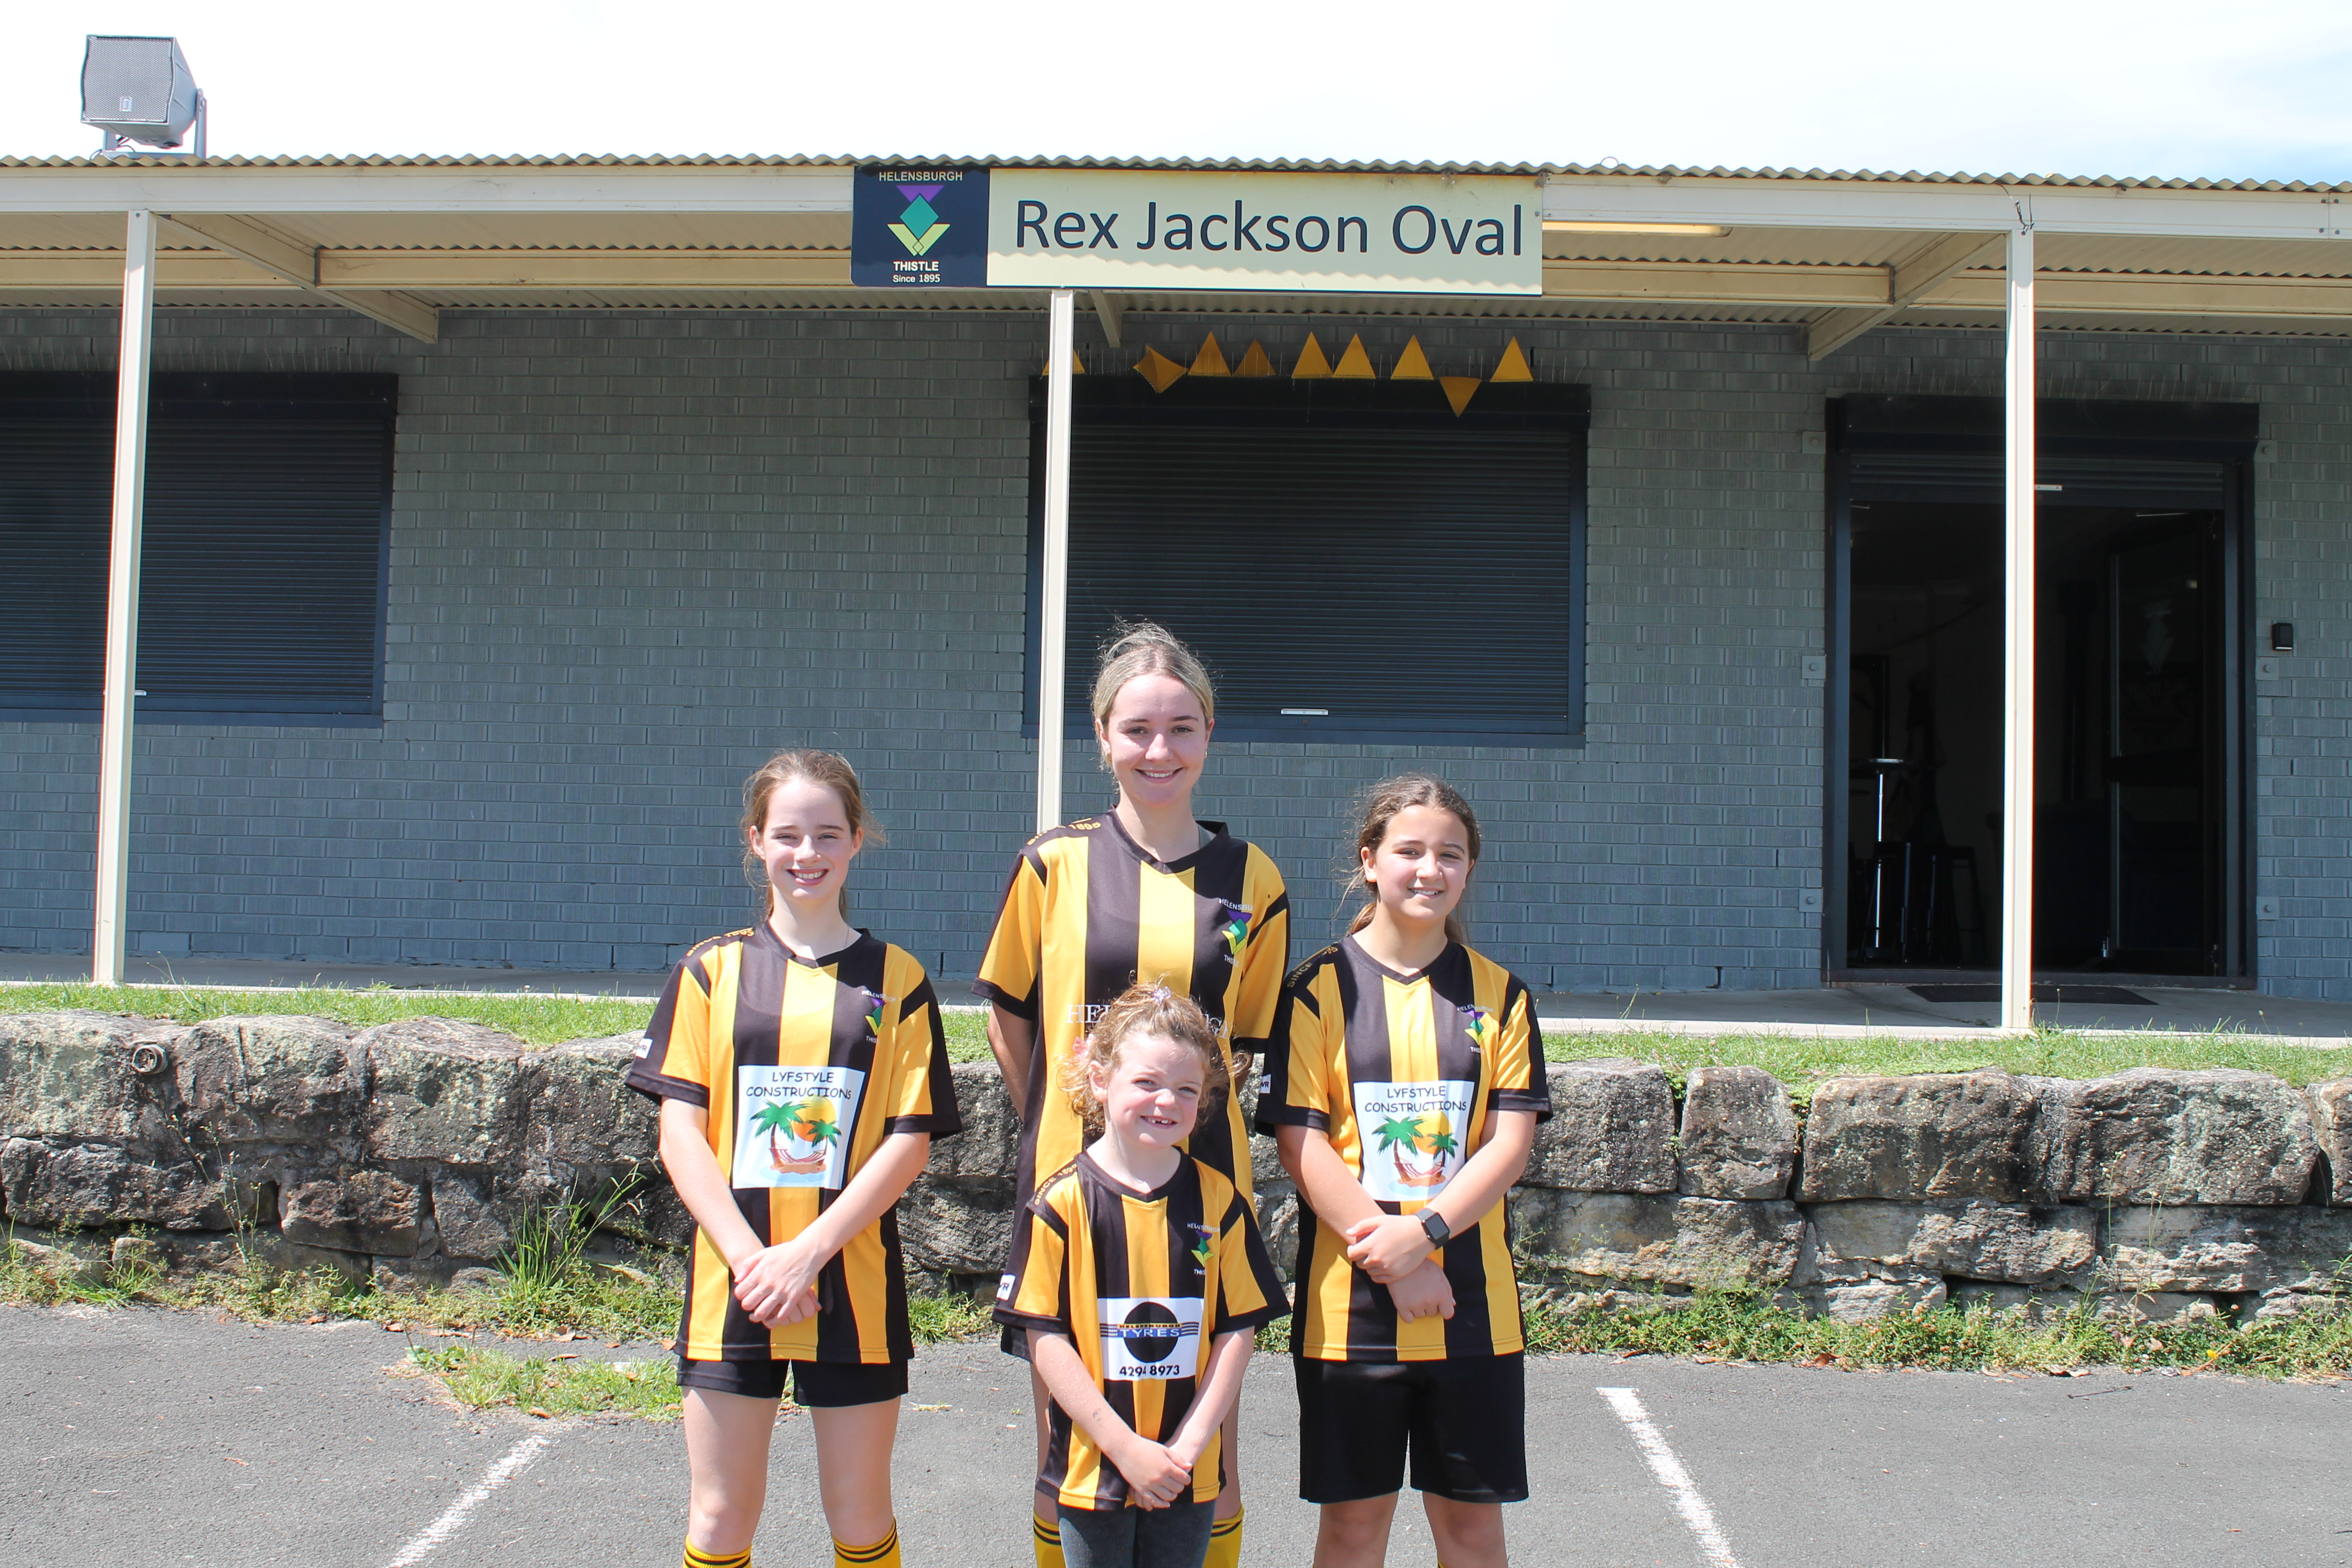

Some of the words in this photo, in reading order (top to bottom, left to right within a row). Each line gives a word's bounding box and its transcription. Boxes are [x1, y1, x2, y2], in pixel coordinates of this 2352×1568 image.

[879, 171, 963, 182] HELENSBURGH
[1016, 199, 1119, 249] Rex
[1136, 199, 1368, 253] Jackson
[1392, 204, 1522, 256] Oval
[892, 261, 939, 271] THISTLE
[892, 274, 916, 283] Since
[918, 274, 940, 283] 1895
[1218, 897, 1254, 911] HELENSBU
[1287, 962, 1313, 988] SINCE
[1457, 1003, 1494, 1012] HELENBURGH
[772, 1071, 835, 1083] LYFSTYLE
[746, 1086, 852, 1100] CONSTRUCTIONS
[1386, 1085, 1446, 1099] LYFSTYLE
[1364, 1101, 1467, 1113] CONSTRUCTIONS
[1035, 1177, 1057, 1206] SINCE
[1119, 1328, 1180, 1338] TYRES
[1119, 1365, 1146, 1377] 4294
[1150, 1364, 1180, 1376] 8973
